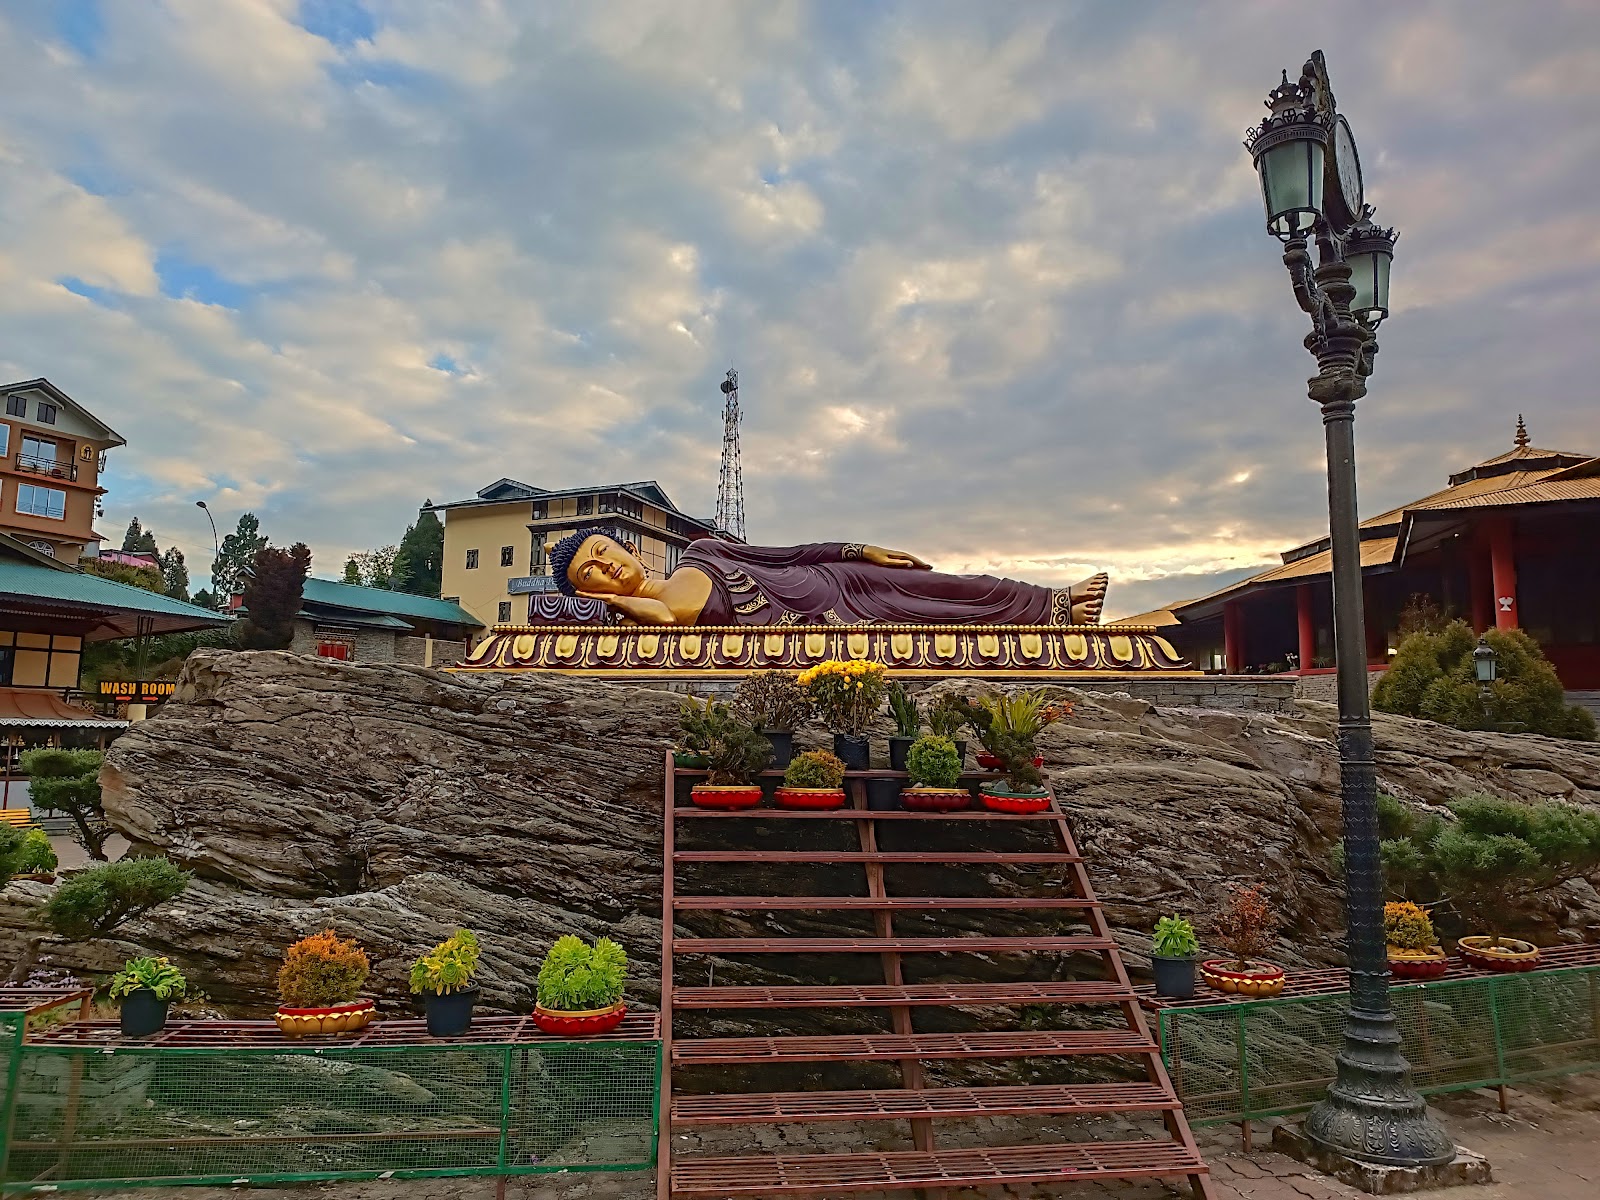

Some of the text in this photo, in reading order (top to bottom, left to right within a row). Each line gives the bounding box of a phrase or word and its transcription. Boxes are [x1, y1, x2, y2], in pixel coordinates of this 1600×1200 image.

[516, 578, 545, 587] Buddha
[100, 682, 175, 695] WASH ROOM
